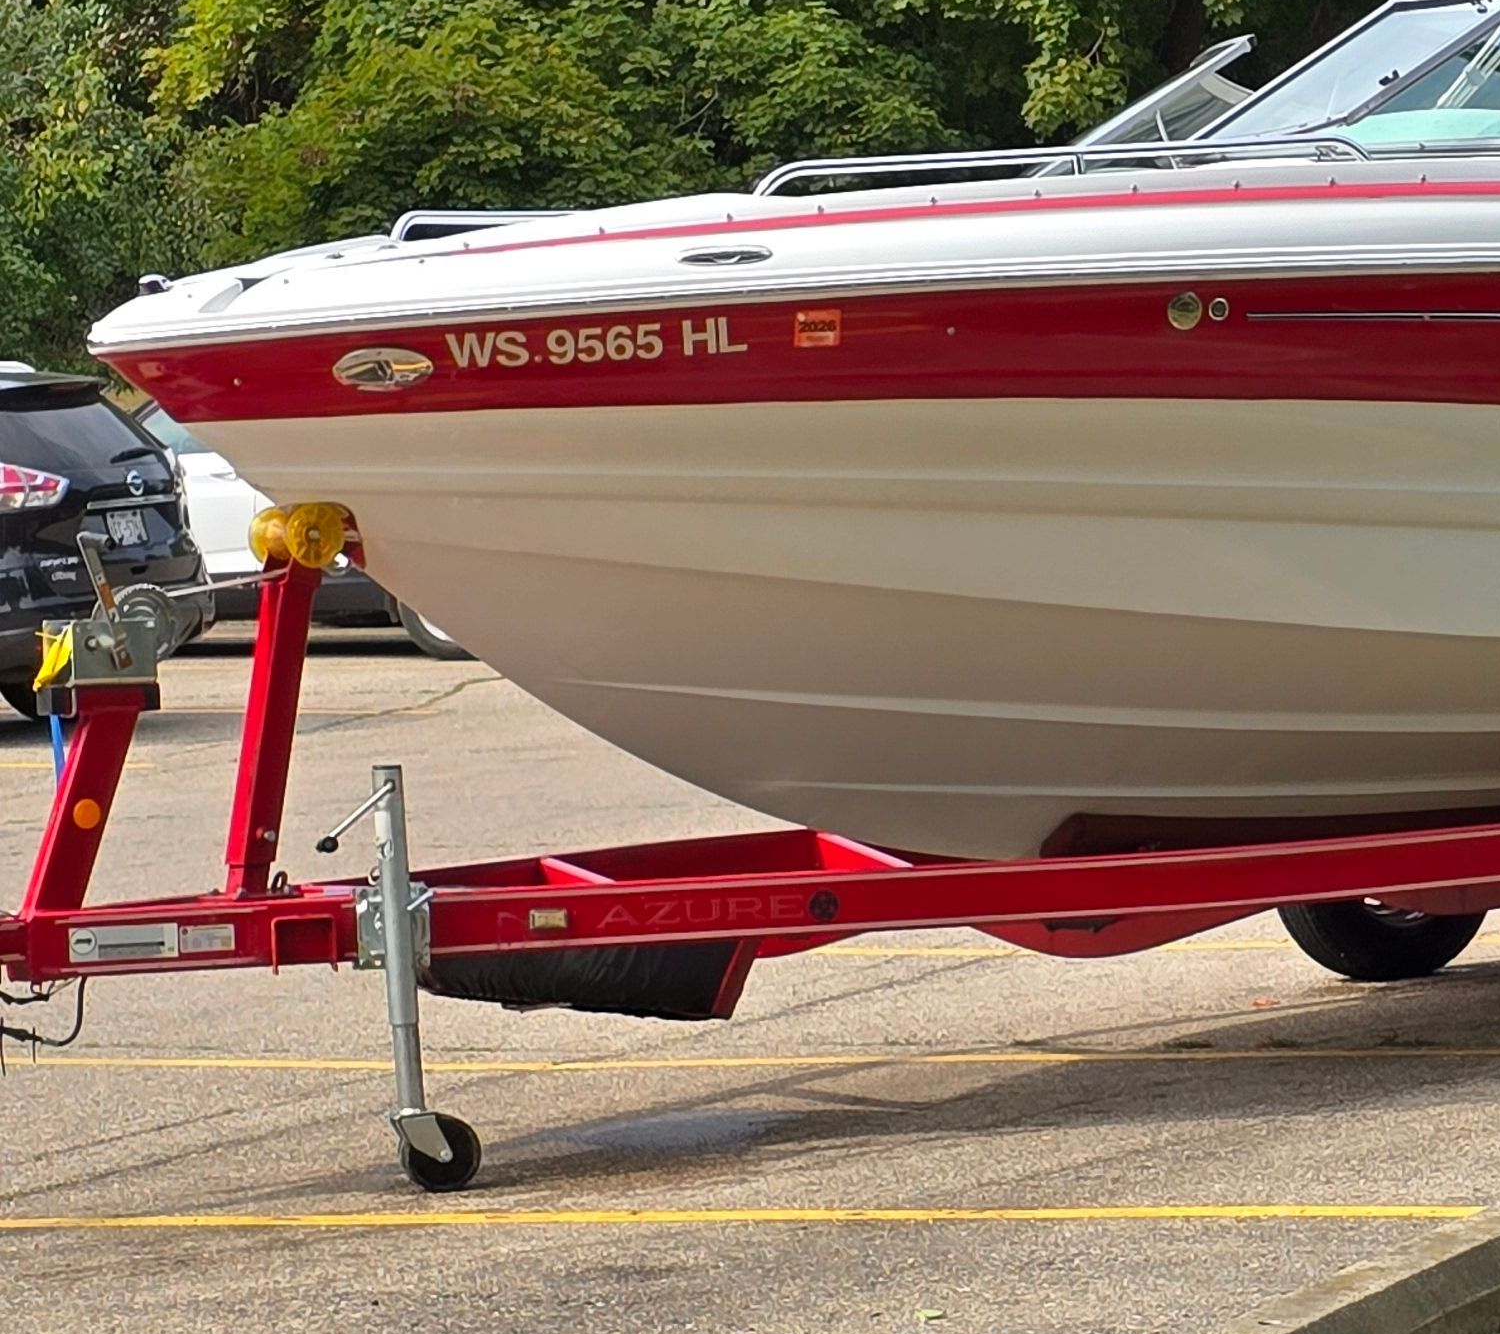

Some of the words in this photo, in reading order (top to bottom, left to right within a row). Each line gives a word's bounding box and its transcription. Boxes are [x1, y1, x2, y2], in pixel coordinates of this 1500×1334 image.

[445, 330, 530, 368] WS
[546, 322, 664, 365] 9565
[681, 316, 748, 356] HL
[798, 319, 837, 334] 2026
[596, 894, 805, 930] AZURE
